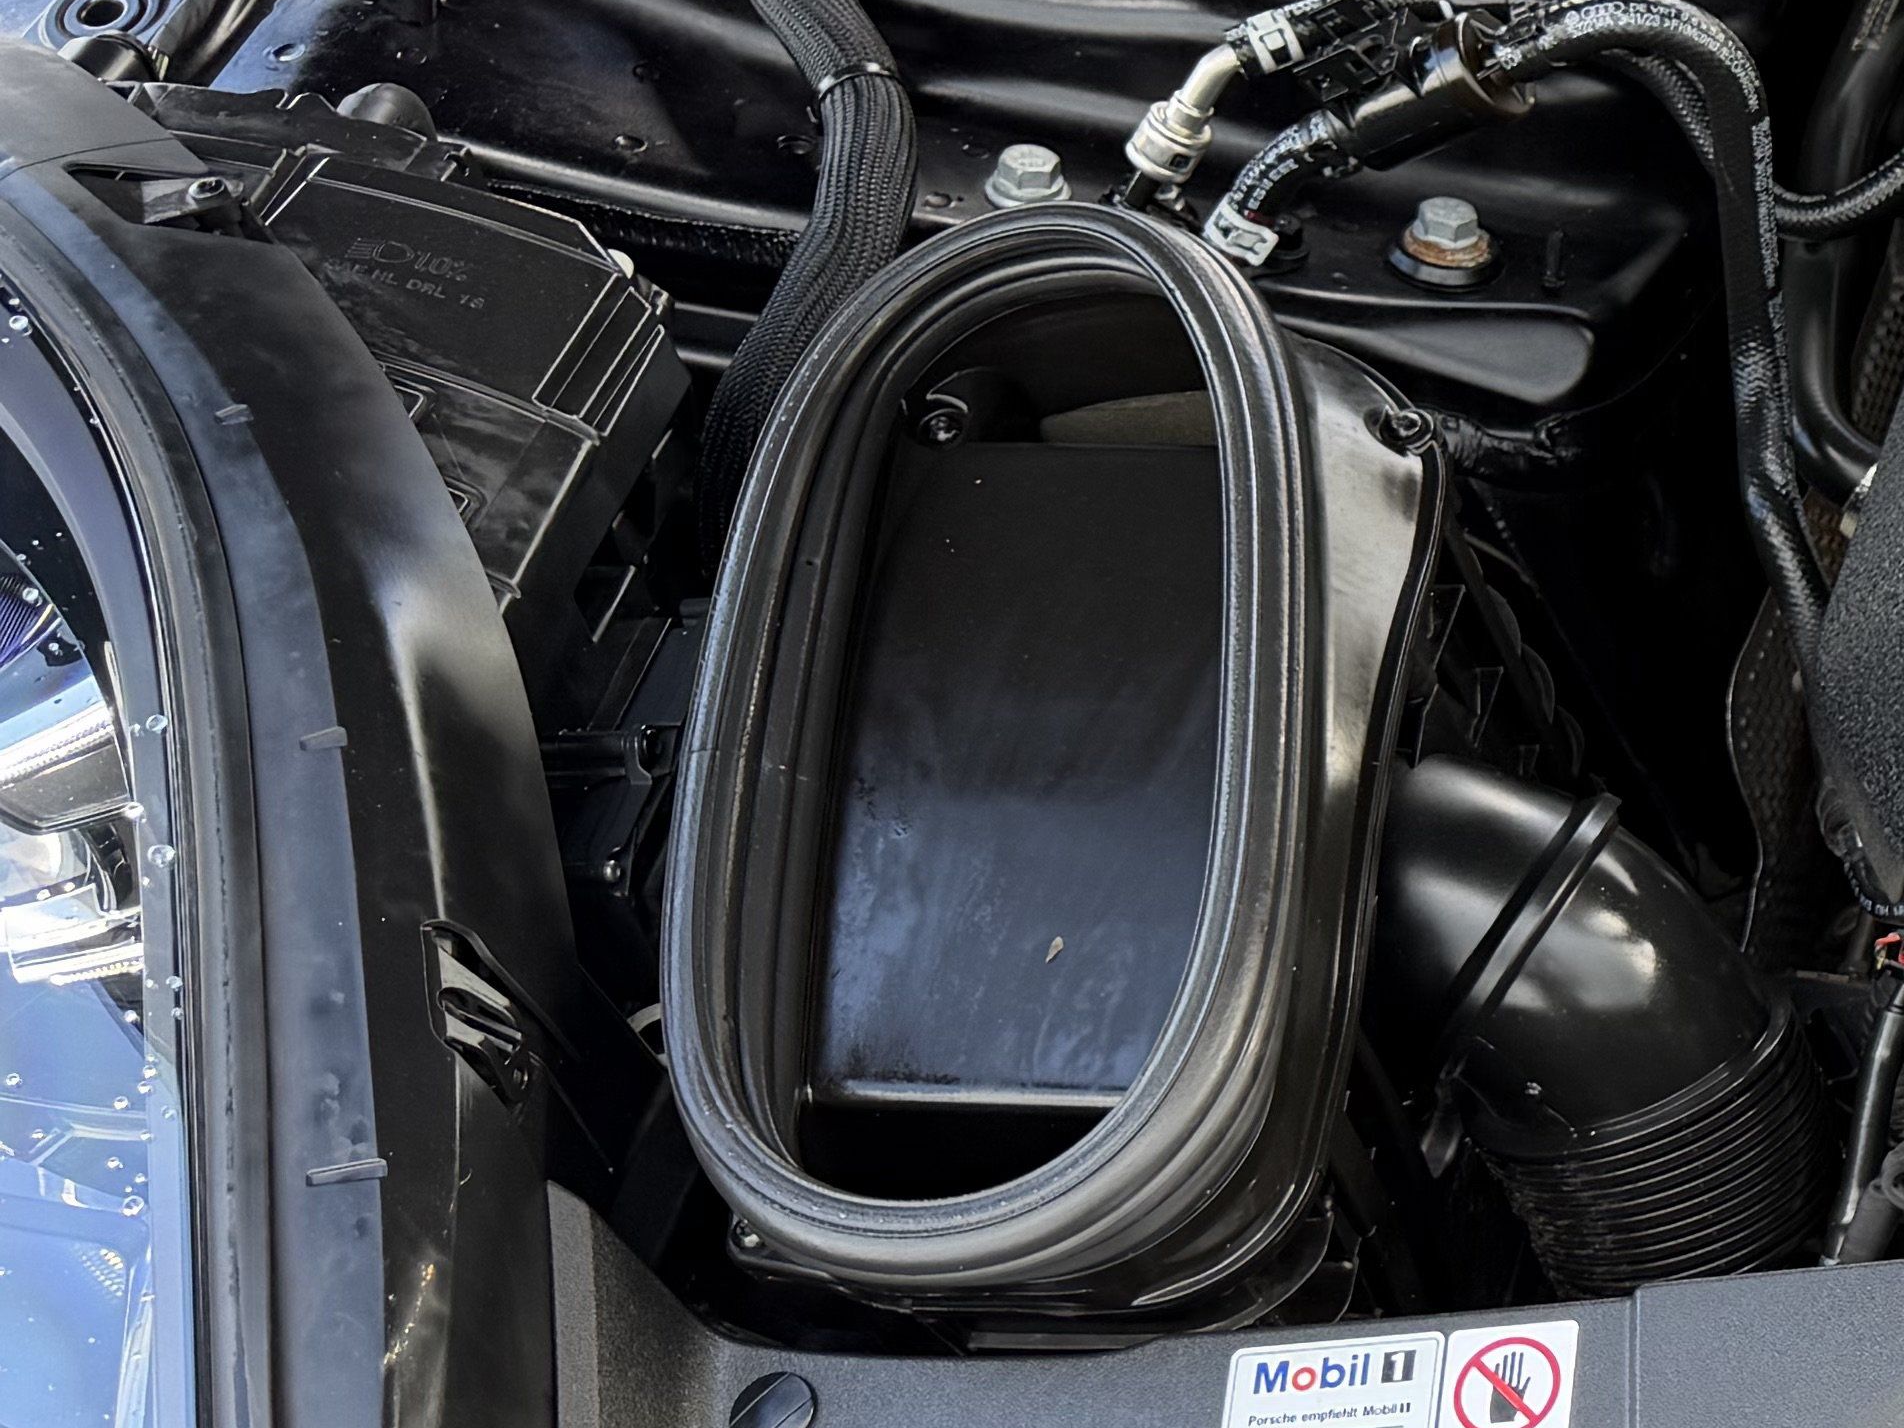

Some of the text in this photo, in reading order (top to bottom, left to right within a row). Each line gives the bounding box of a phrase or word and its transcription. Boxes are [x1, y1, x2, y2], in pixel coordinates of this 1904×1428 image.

[1252, 1353, 1371, 1395] Mobil
[1248, 1412, 1298, 1427] Porsche
[1301, 1408, 1358, 1423] empfiehlt
[1362, 1403, 1397, 1417] Mobil
